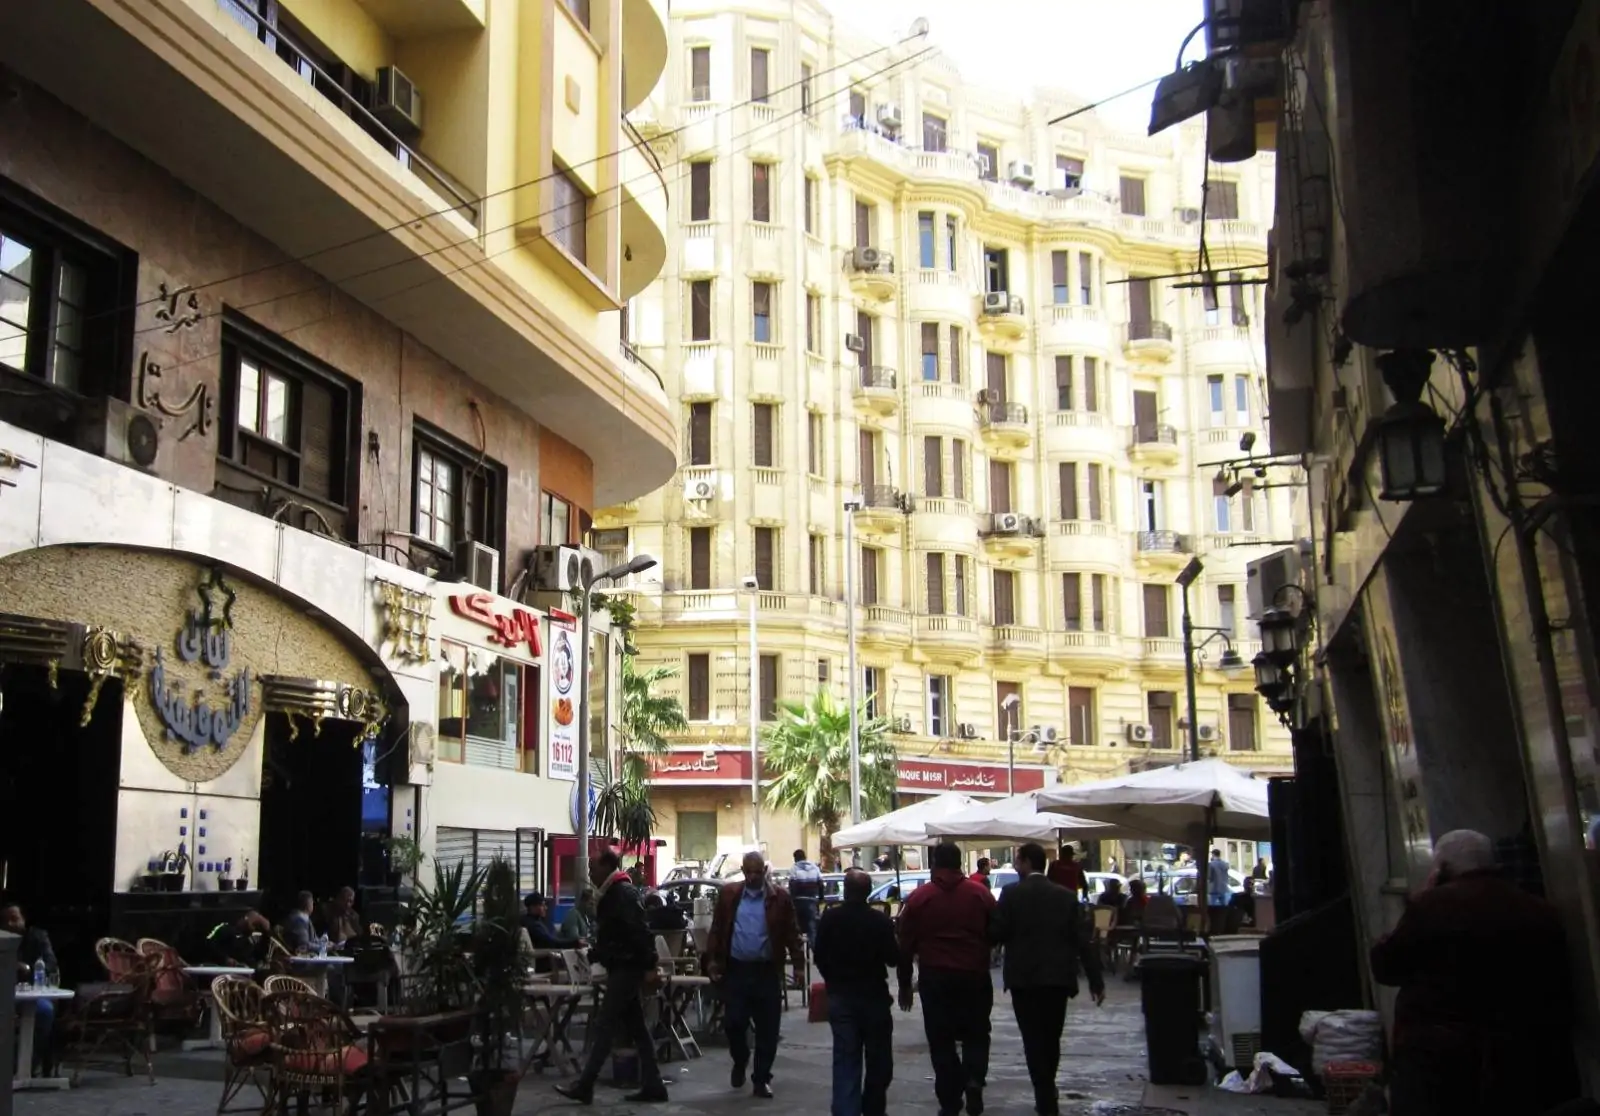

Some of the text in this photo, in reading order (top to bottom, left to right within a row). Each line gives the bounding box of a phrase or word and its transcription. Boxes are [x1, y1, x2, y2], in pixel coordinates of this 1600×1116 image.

[552, 742, 573, 763] 16112
[896, 769, 942, 782] ANQUE MISR
